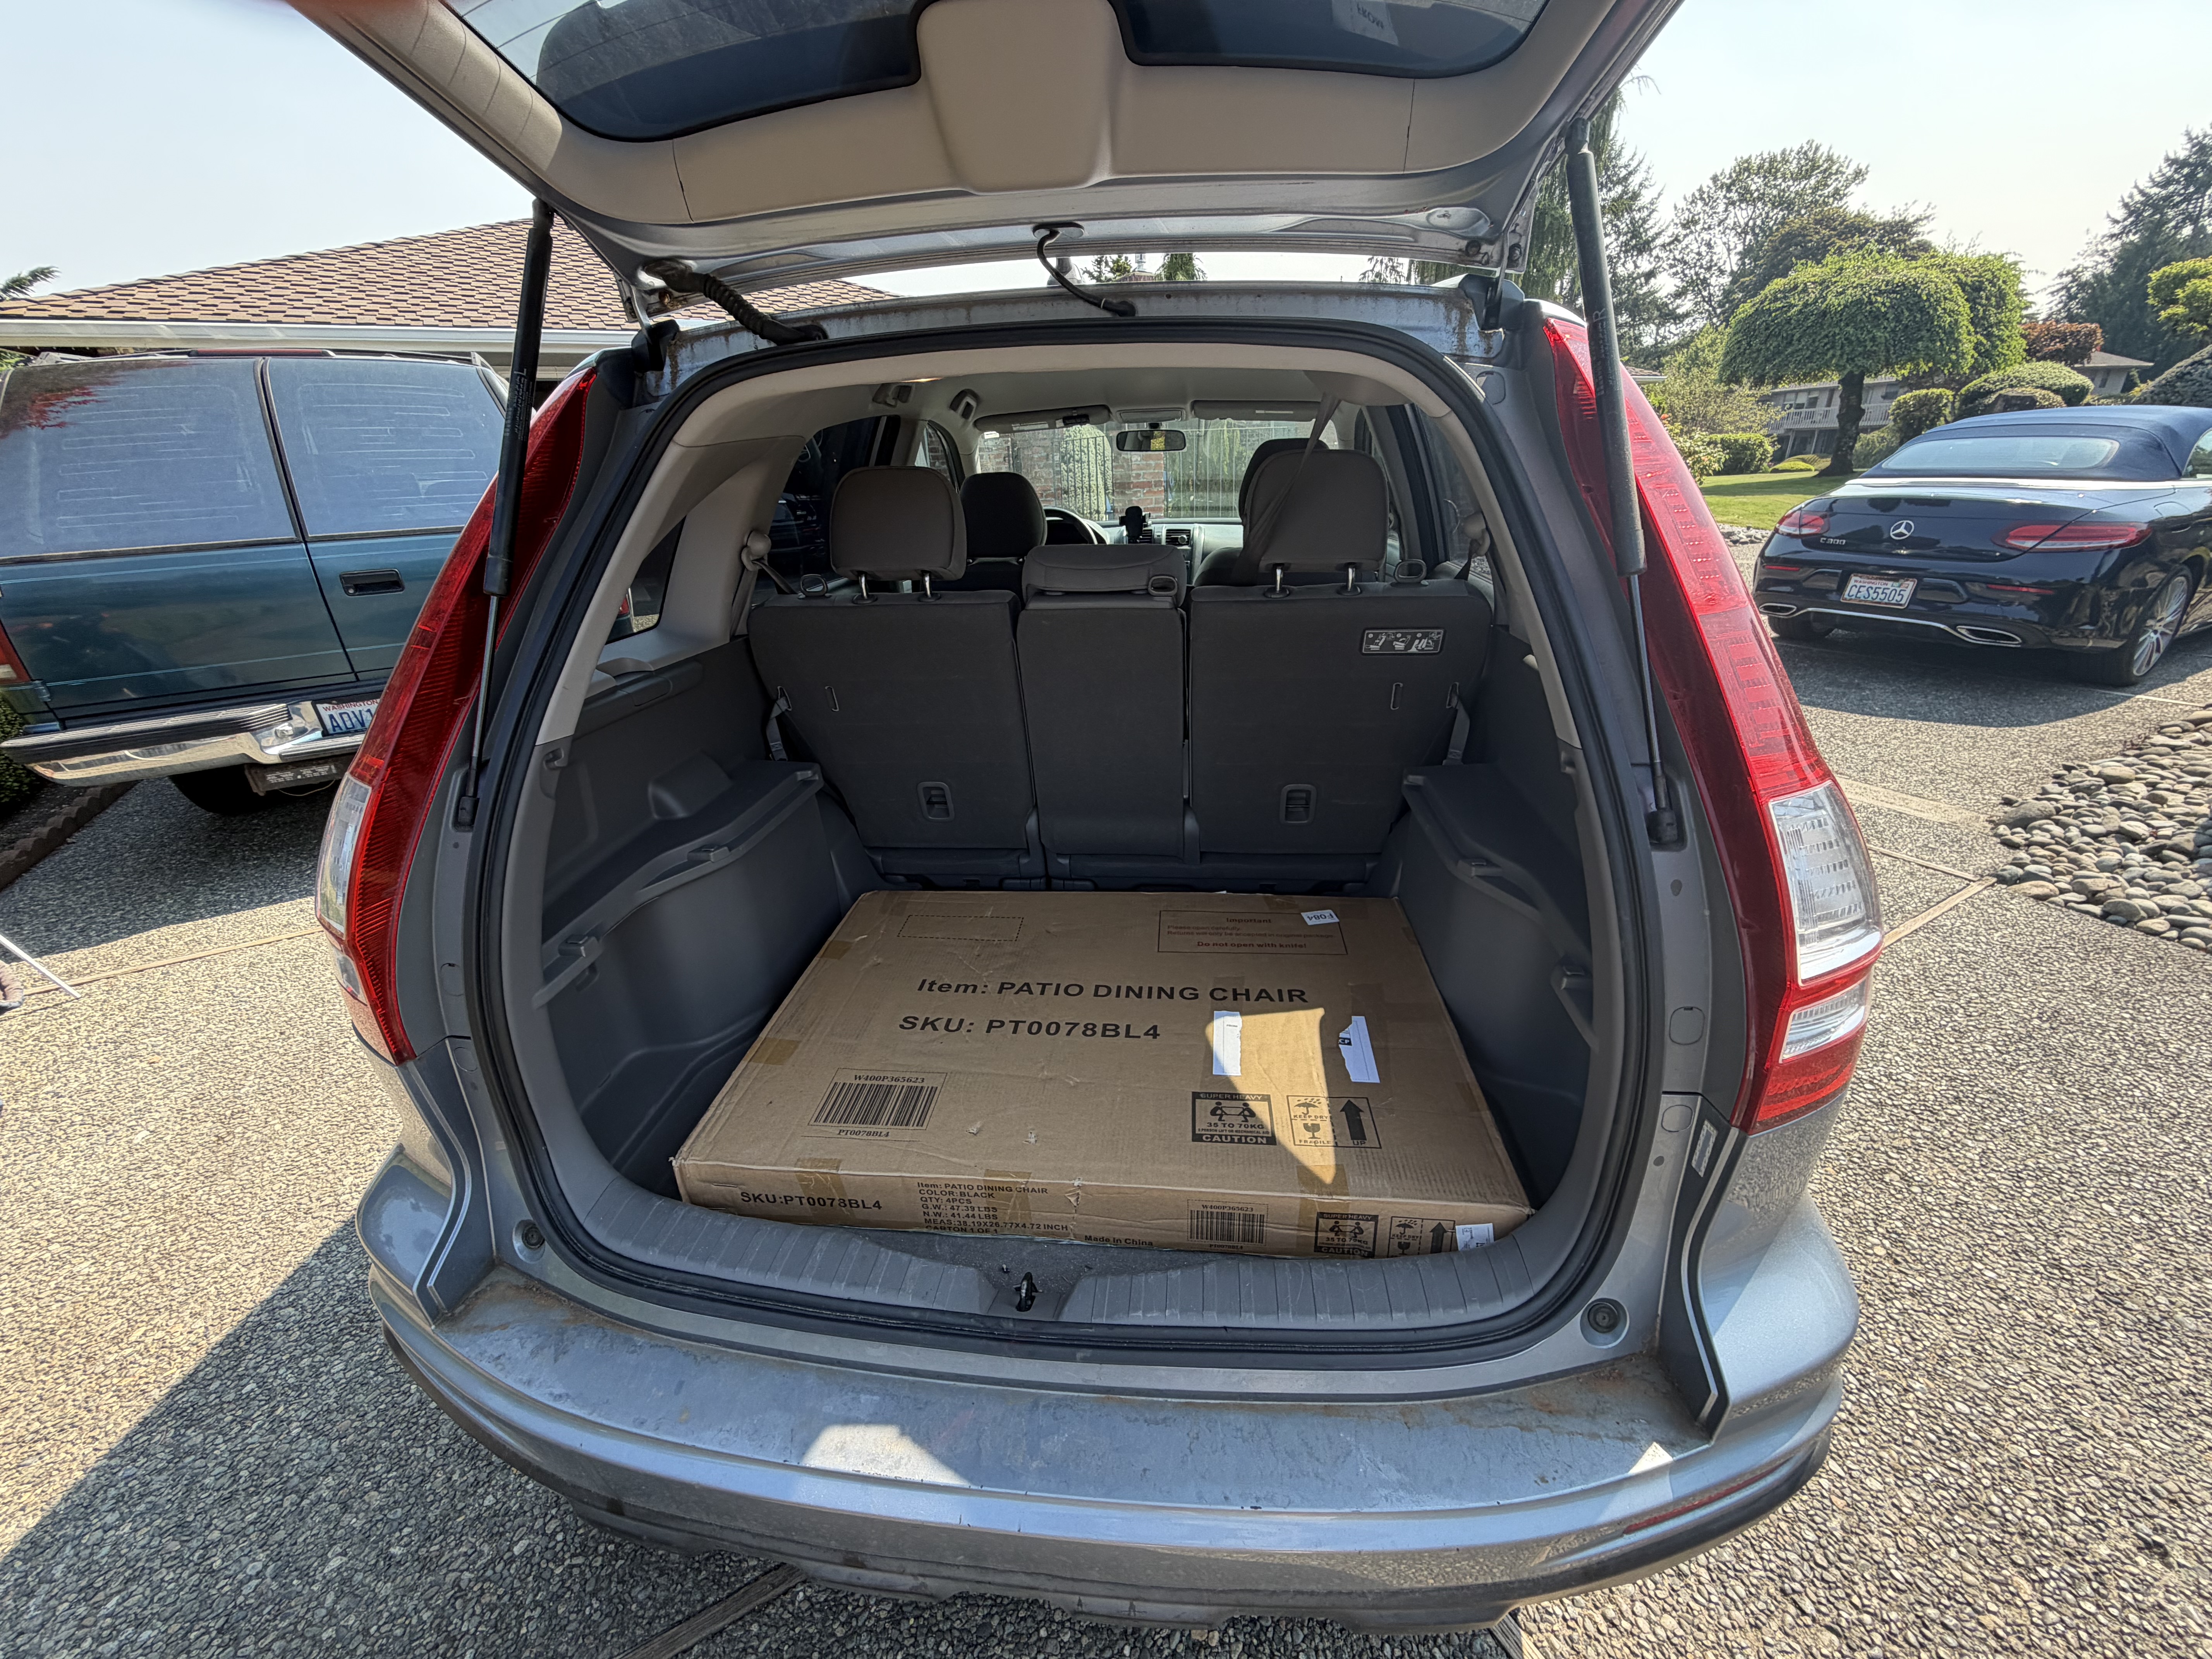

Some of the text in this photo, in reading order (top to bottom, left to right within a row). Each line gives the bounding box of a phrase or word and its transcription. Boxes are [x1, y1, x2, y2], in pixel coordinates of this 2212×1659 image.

[1593, 308, 1607, 322] R
[1848, 584, 1906, 603] CES5505
[323, 699, 378, 711] WASHINGTON
[918, 979, 1309, 1003] Item: PATIO DINING CHAIR
[899, 1016, 1160, 1039] SKU: PT0078BL4
[854, 1075, 925, 1084] W400P365623
[838, 1129, 890, 1138] PT0078BL4
[1202, 1135, 1267, 1144] CAUTION
[919, 1189, 995, 1199] COLOR:BLACK
[740, 1191, 883, 1210] SKU:PT0078BL4
[1201, 1204, 1254, 1212] W400P365623
[924, 1218, 1041, 1230] MEAS:38.19X26.77X4.72
[1125, 1238, 1153, 1246] China
[1321, 1247, 1368, 1256] CAUTION
